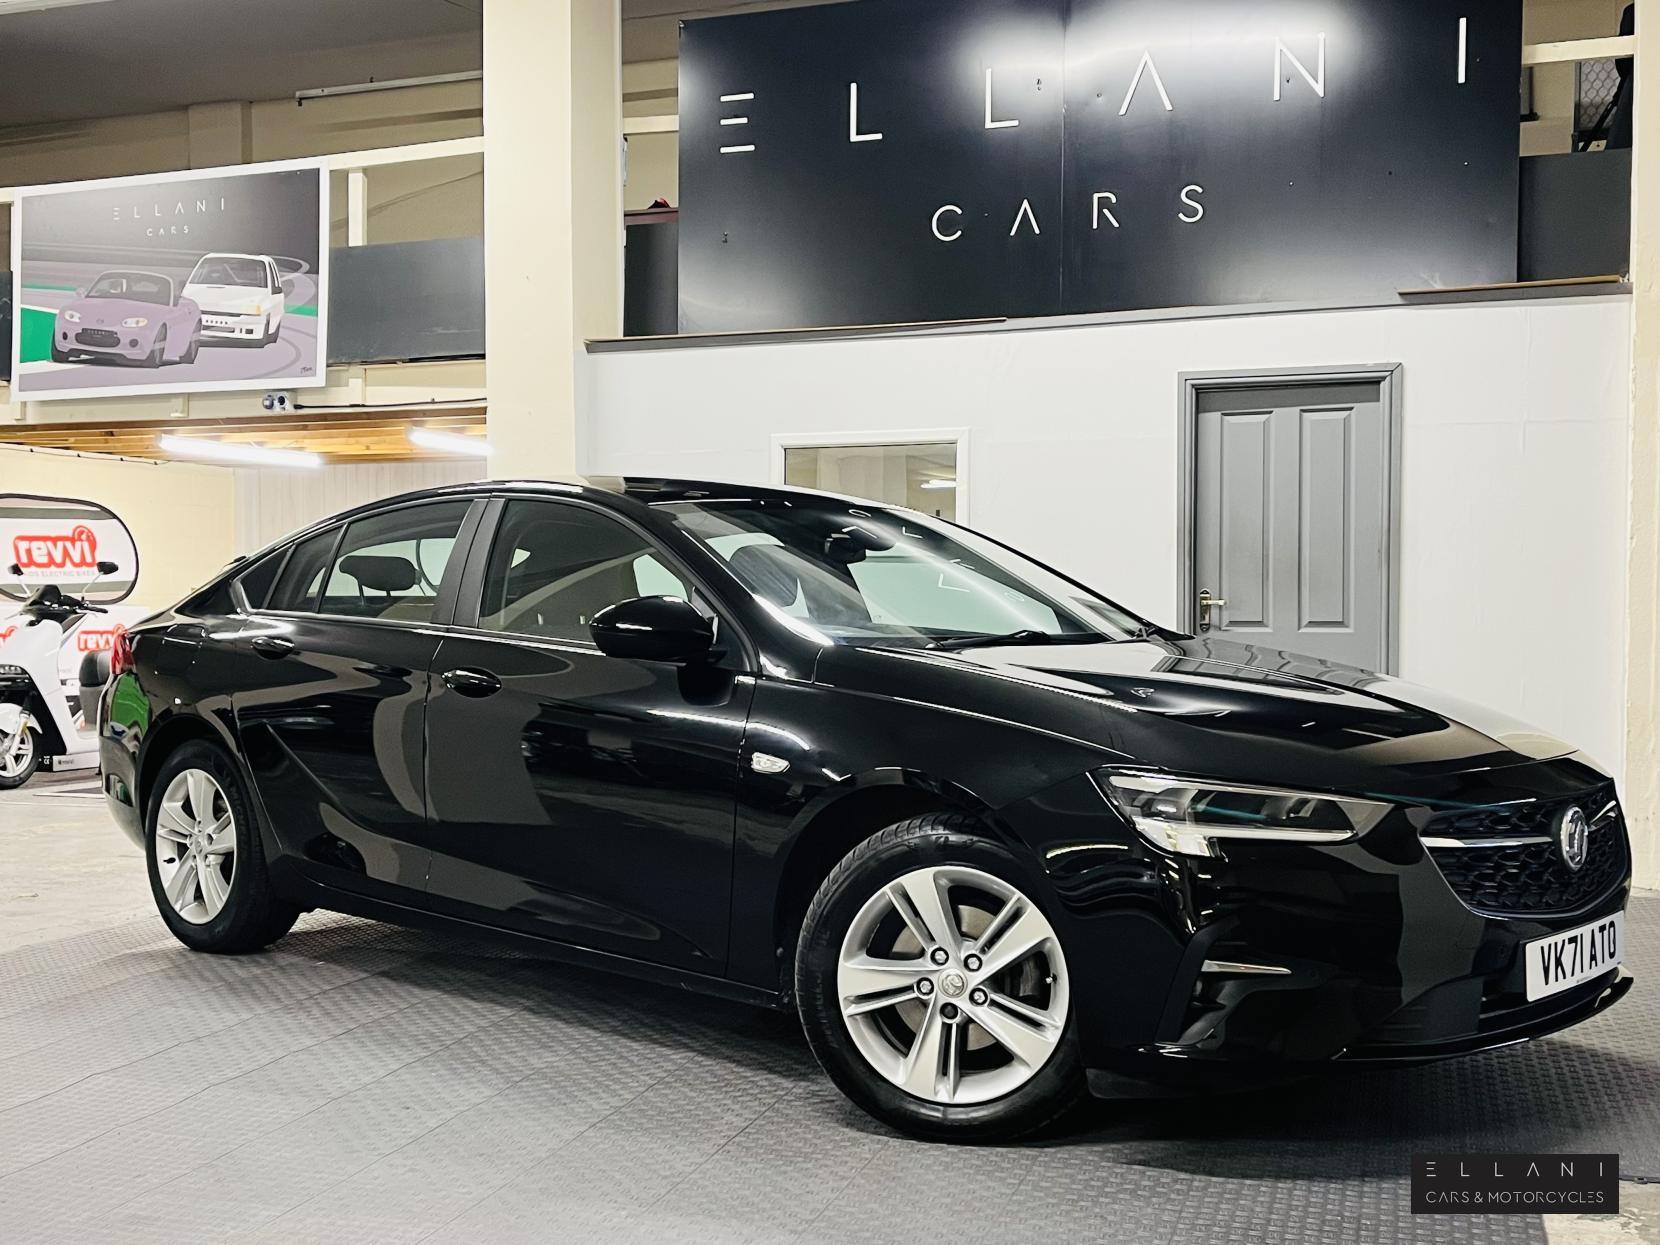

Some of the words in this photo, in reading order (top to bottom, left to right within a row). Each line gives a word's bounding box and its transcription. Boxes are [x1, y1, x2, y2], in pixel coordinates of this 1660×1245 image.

[719, 16, 1468, 154] ELLANI
[112, 197, 225, 220] ELLANI
[931, 184, 1205, 242] CARS
[146, 225, 189, 237] CARS
[16, 530, 94, 564] revvi
